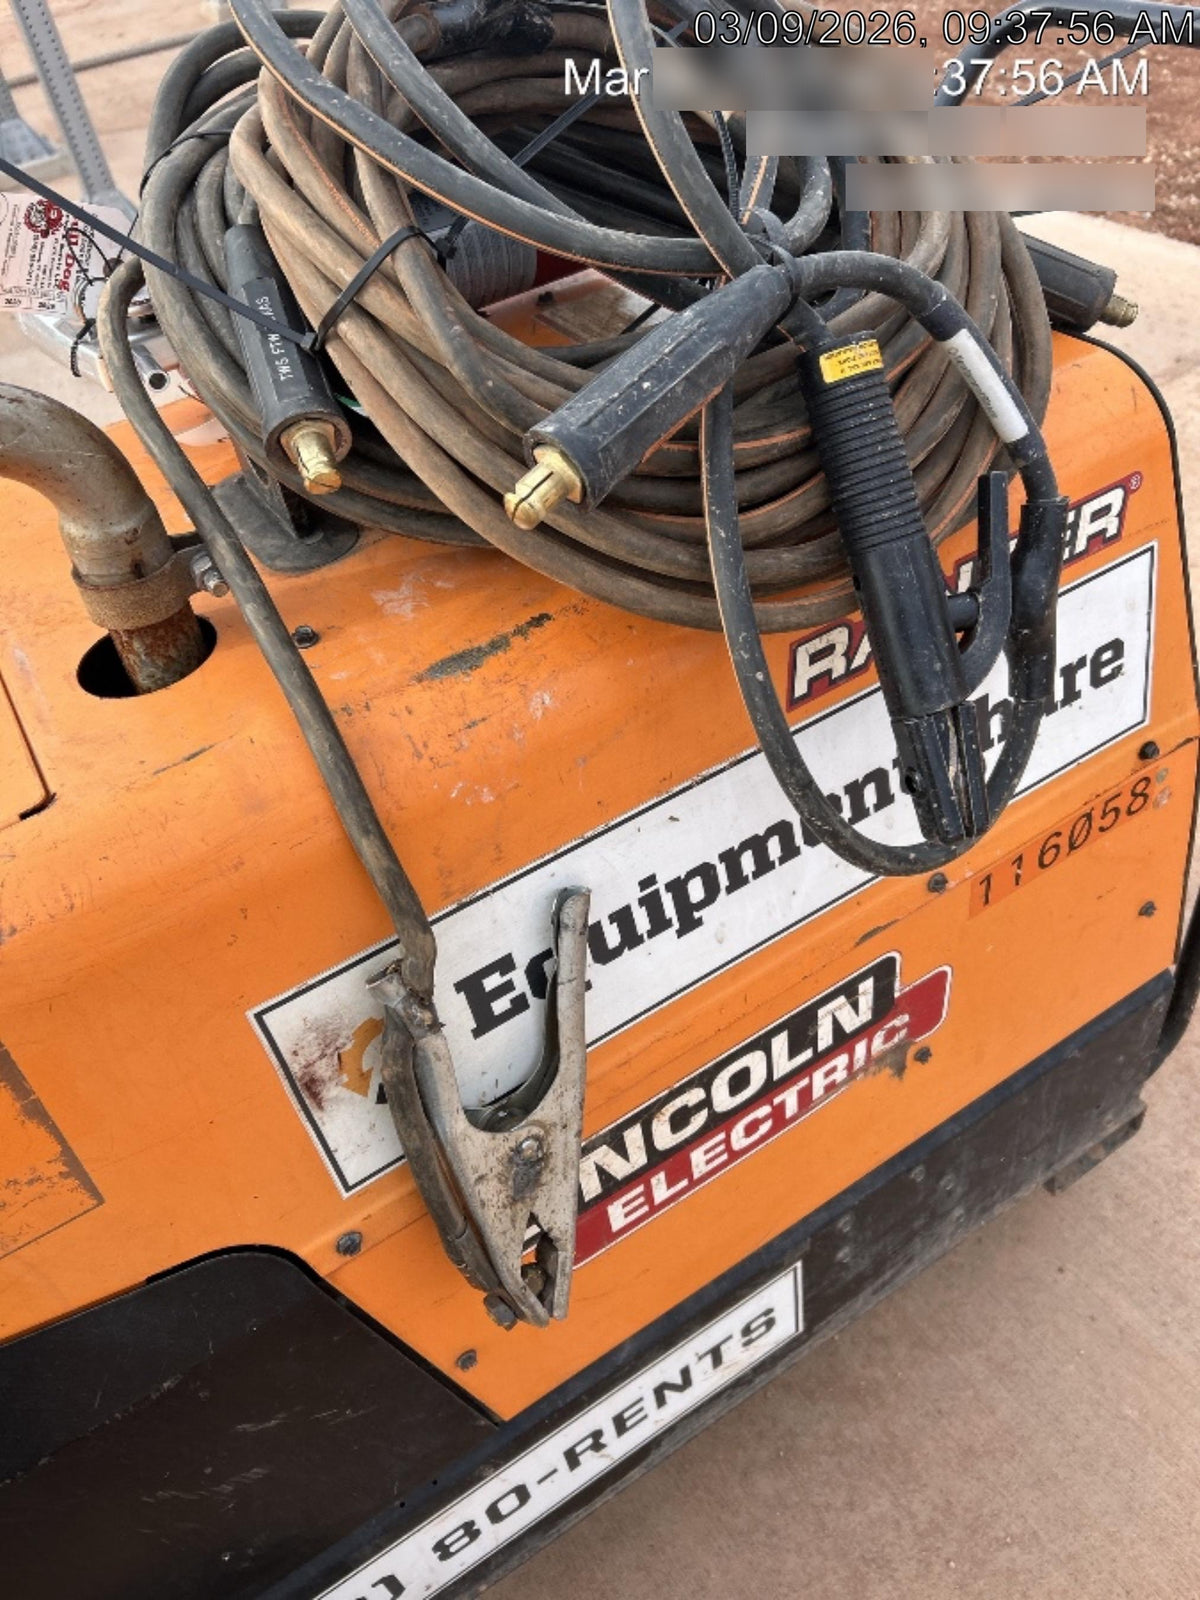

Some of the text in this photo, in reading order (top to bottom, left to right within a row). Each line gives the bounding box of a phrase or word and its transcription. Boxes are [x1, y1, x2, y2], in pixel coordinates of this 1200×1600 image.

[579, 976, 875, 1203] NCOLN
[607, 1014, 910, 1233] ELECTRIC
[432, 1307, 776, 1562] 80-RENTS
